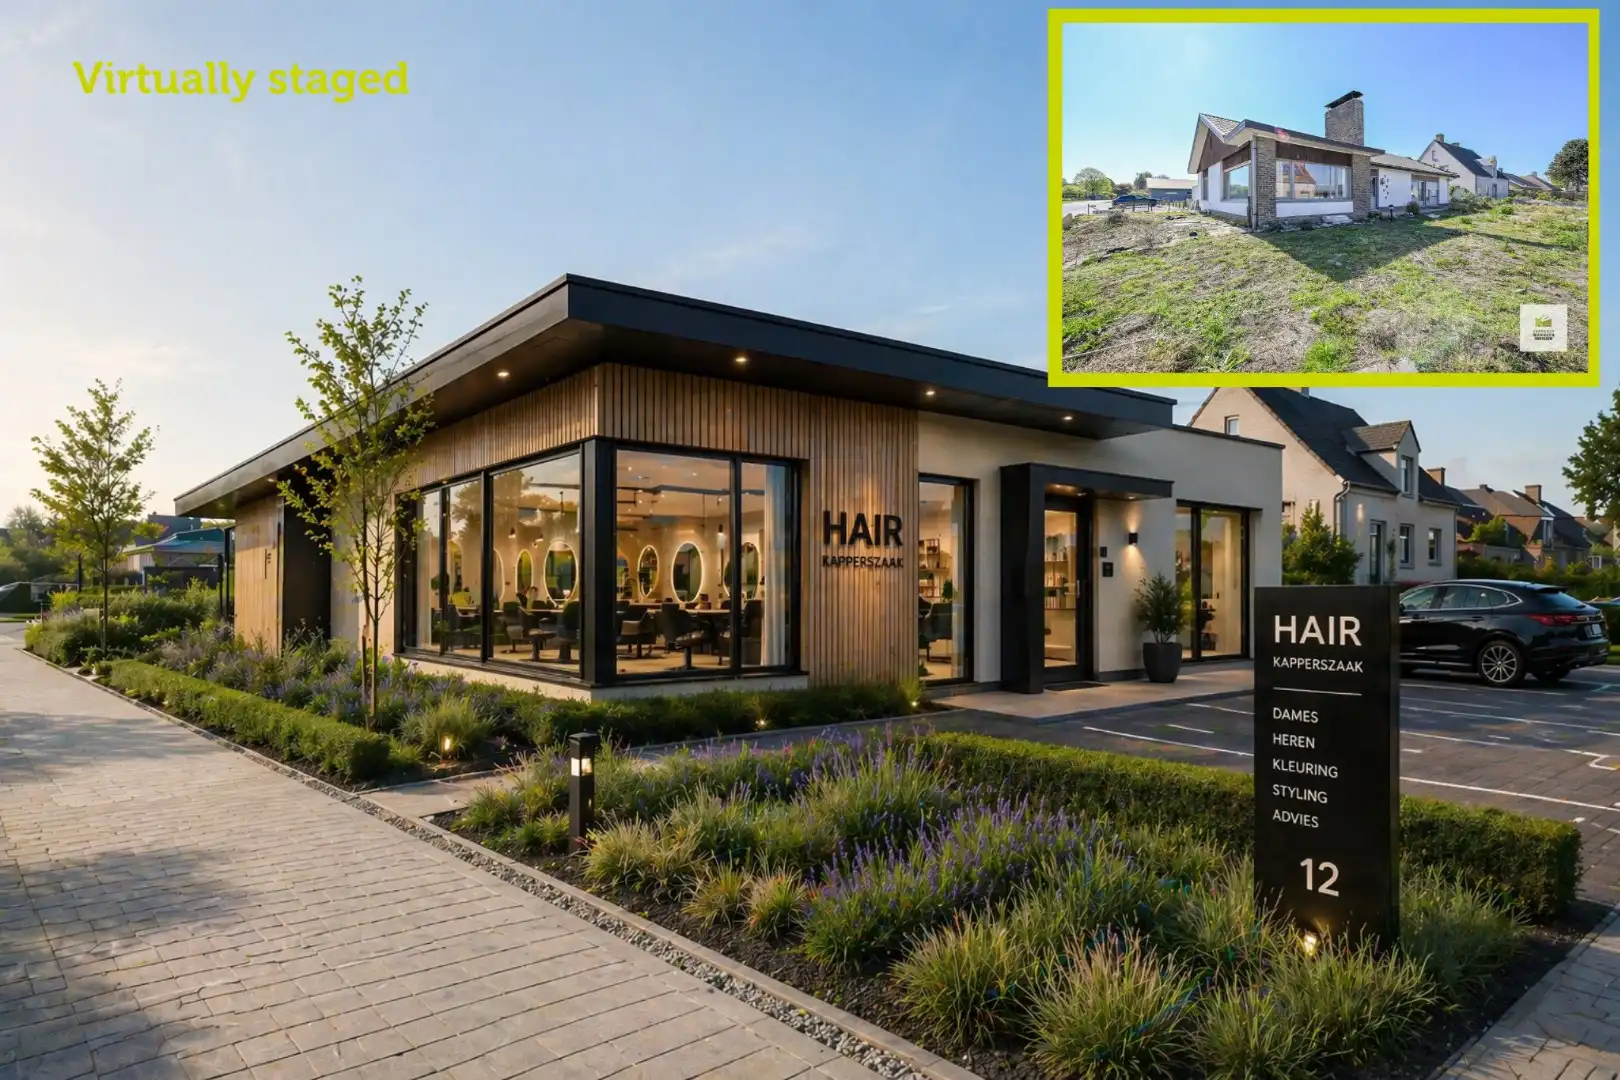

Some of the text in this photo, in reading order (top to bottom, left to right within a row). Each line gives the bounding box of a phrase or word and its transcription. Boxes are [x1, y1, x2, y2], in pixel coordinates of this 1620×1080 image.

[823, 510, 903, 546] HAIR
[822, 555, 904, 569] KAPPERSZAAK
[1273, 615, 1362, 646] HAIR
[1272, 656, 1364, 673] KAPPERSZAAK
[1272, 707, 1319, 723] DAMES
[1272, 733, 1315, 749] HEREN
[1272, 758, 1338, 778] KLEURING
[1272, 784, 1328, 803] STYLING
[1272, 809, 1319, 828] ADVIES
[1300, 858, 1339, 897] 12
